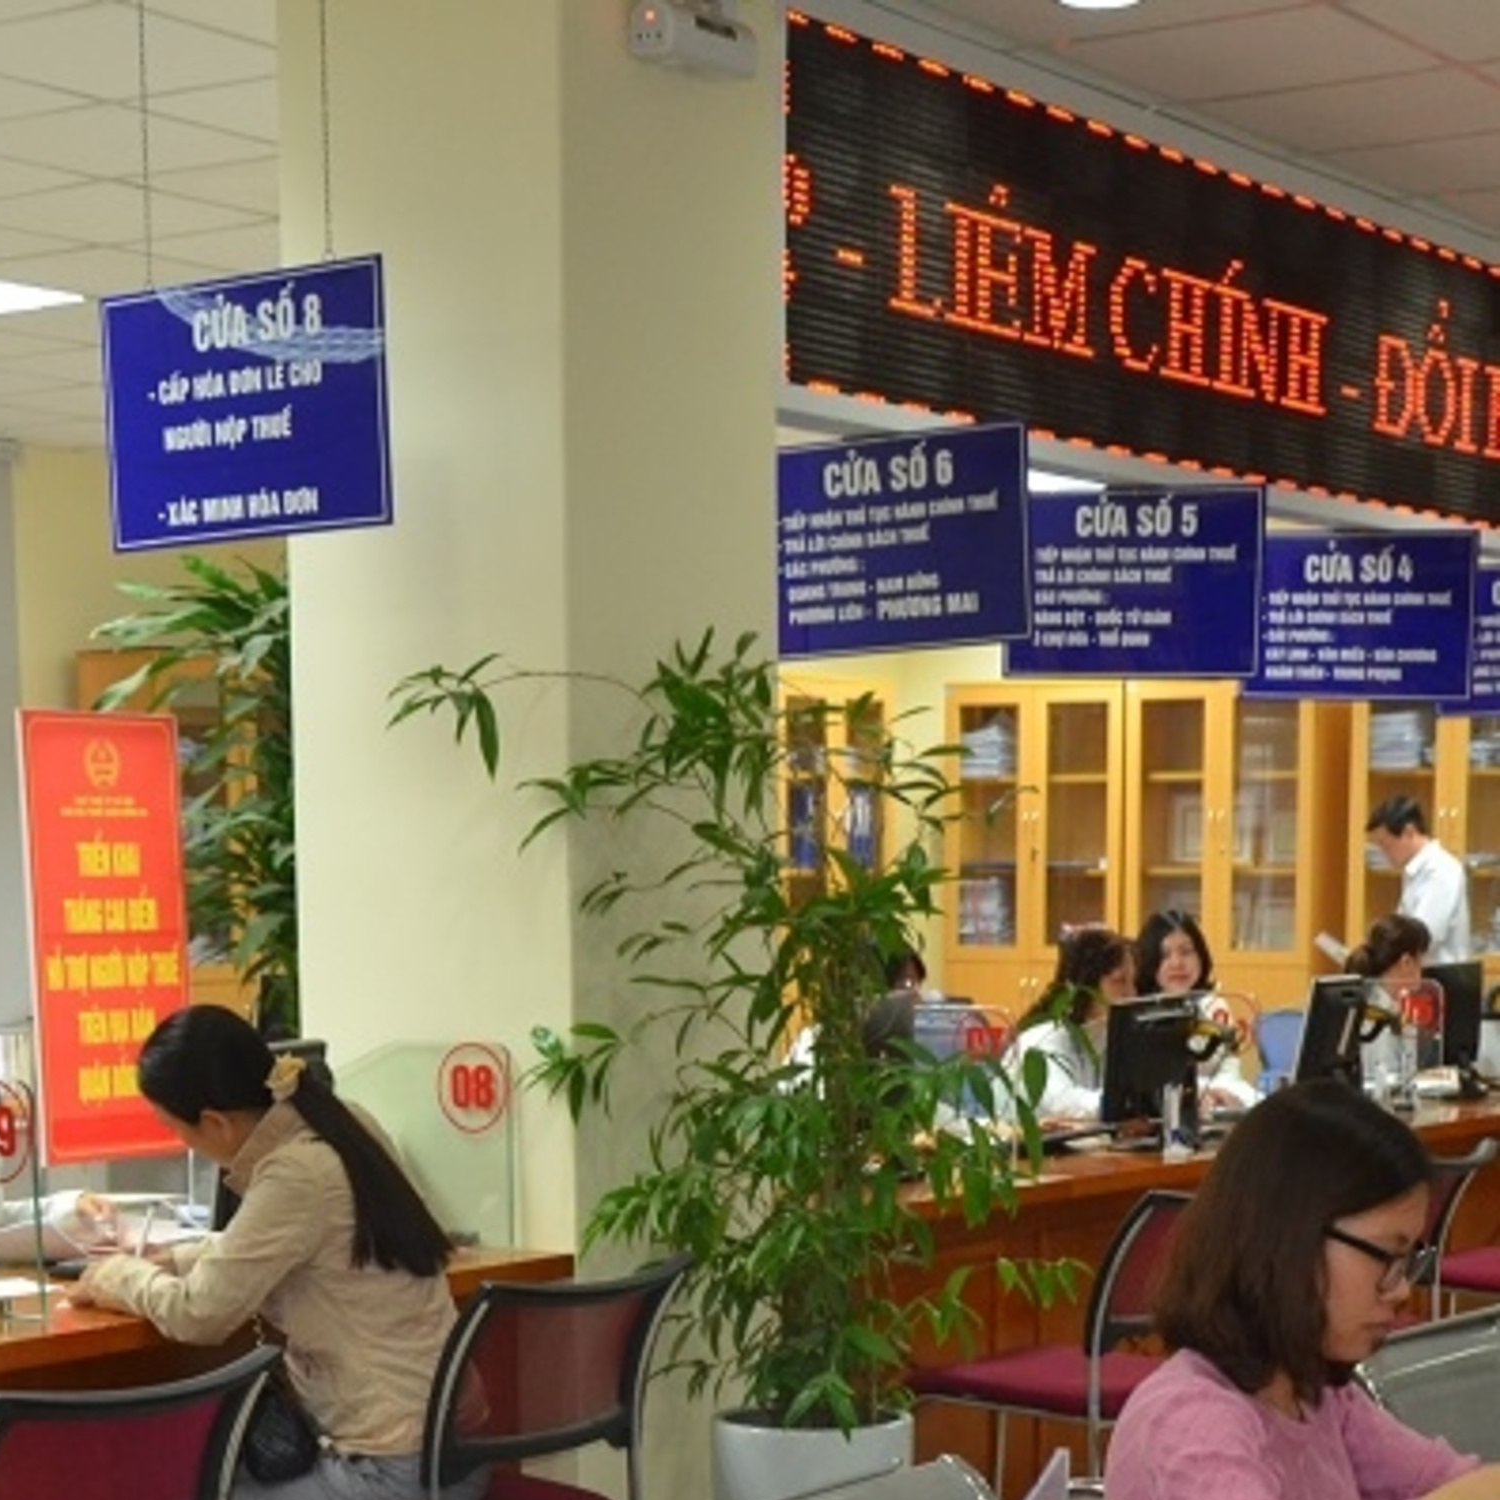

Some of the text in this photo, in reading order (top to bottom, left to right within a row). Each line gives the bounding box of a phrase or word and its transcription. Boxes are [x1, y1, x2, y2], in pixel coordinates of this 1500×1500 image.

[192, 280, 323, 352] CỬA SỐ 8
[890, 184, 1097, 357] LIÊM
[1108, 259, 1329, 416] CHÍNH
[823, 439, 954, 498] CỬA SỐ 6
[1075, 493, 1199, 538] CỬA SỐ 5
[1304, 539, 1414, 583] CỬA SỐ 4
[450, 1063, 497, 1111] 08
